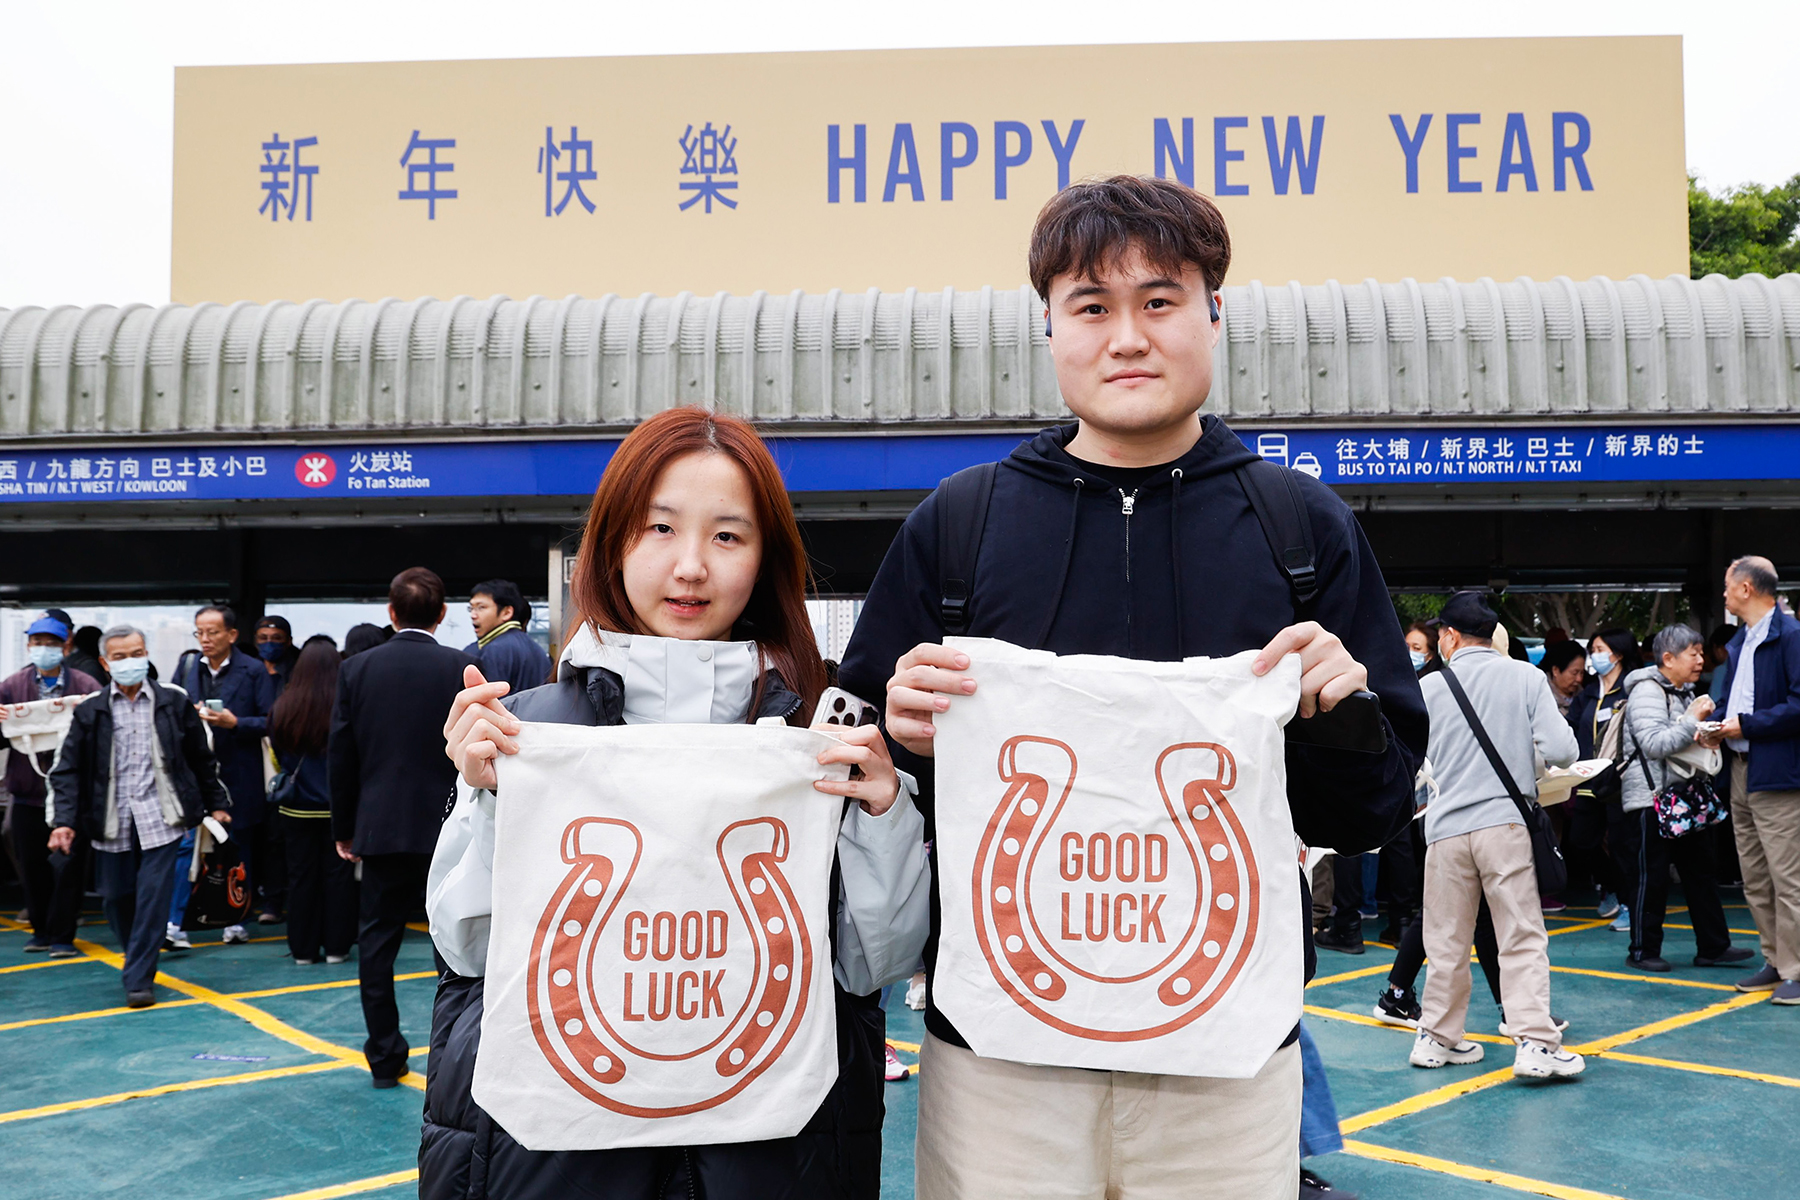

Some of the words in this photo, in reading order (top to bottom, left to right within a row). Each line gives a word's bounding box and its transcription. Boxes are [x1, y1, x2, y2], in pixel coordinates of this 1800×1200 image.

[260, 122, 738, 221] 新年快樂
[828, 120, 1084, 204] HAPPY
[1154, 116, 1324, 195] NEW
[1390, 112, 1594, 193] YEAR
[349, 451, 413, 473] 火炭站
[1336, 438, 1410, 461] 往大埔
[1440, 437, 1514, 460] 新界北
[1527, 437, 1574, 457] 巴士
[1604, 434, 1704, 457] 新界的士
[0, 482, 24, 495] SHA
[25, 481, 48, 494] TIN
[57, 481, 79, 494] N.T
[81, 481, 115, 494] WEST
[124, 479, 188, 493] KOWLOON
[46, 458, 140, 480] 九龍方向
[152, 456, 268, 478] 巴士及小巴
[348, 477, 363, 489] Fo
[364, 477, 386, 489] Tan
[388, 475, 430, 489] Station
[1338, 463, 1363, 476] BUS
[1367, 463, 1385, 475] TO
[1388, 462, 1410, 475] TAI
[1415, 462, 1432, 475] PO
[1443, 462, 1465, 475] N.T
[1469, 461, 1514, 474] NORTH
[1525, 461, 1547, 473] N.T
[1550, 460, 1582, 473] TAXI
[1060, 832, 1168, 882] GOOD
[624, 910, 728, 962] GOOD
[1061, 893, 1166, 943] LUCK
[624, 969, 726, 1022] LUCK
